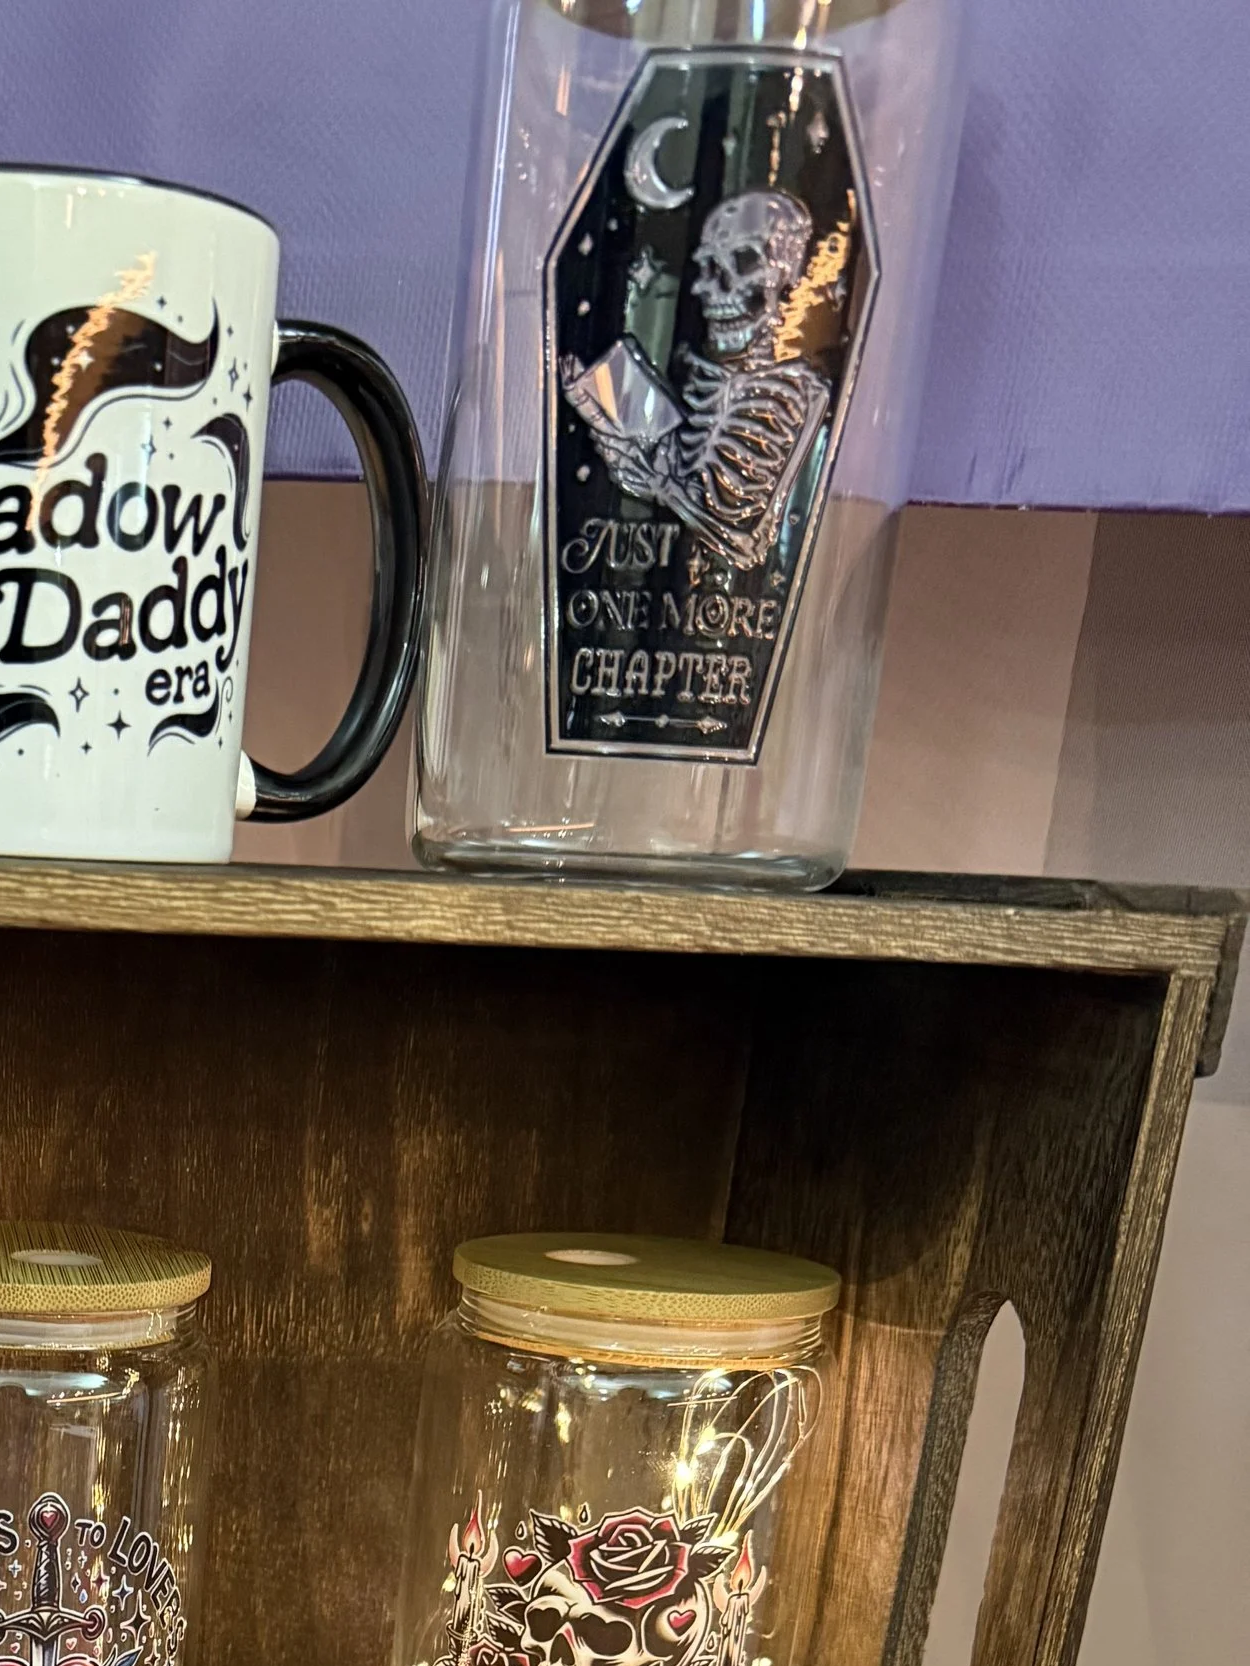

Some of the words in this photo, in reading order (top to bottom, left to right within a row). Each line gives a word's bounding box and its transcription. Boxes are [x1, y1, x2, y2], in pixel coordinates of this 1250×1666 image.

[561, 517, 681, 576] JUST
[566, 588, 650, 632] ONE
[657, 591, 779, 641] MORE
[145, 658, 211, 706] era
[570, 646, 753, 705] CHAPTER
[74, 1519, 107, 1548] TO
[107, 1515, 187, 1660] LOVERS
